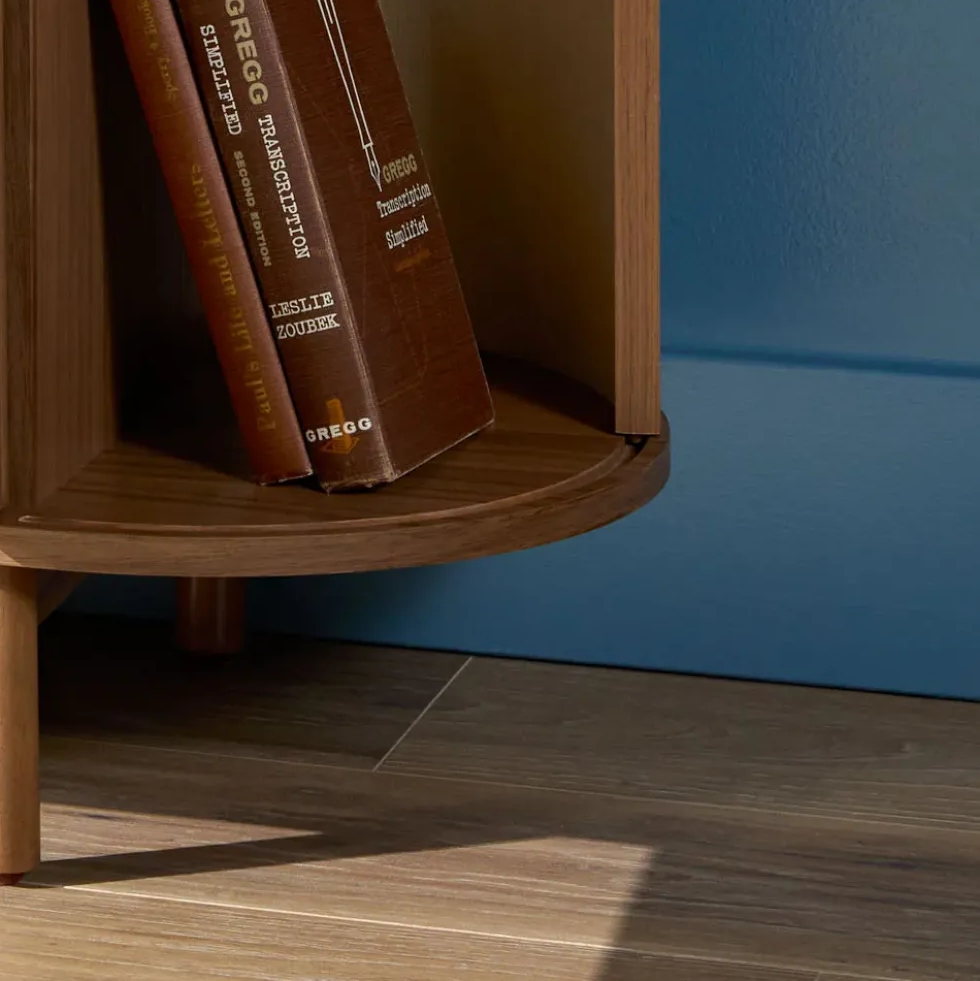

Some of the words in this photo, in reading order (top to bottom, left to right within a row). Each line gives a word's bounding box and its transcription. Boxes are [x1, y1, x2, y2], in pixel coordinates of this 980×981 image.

[200, 24, 243, 136] SIMPLIFIED
[233, 151, 256, 207] SECOND
[250, 211, 272, 267] EDITION
[258, 114, 311, 259] TRANSCRIPTION
[382, 154, 417, 183] GREGG
[191, 164, 223, 248] Letters
[377, 183, 432, 219] Transcription
[386, 216, 429, 250] Simplified
[211, 255, 237, 298] and
[269, 291, 334, 319] LESLIE
[230, 307, 253, 352] Life
[277, 313, 340, 340] ZOUBEK
[245, 361, 276, 431] Paul's
[306, 417, 372, 443] GREGG
